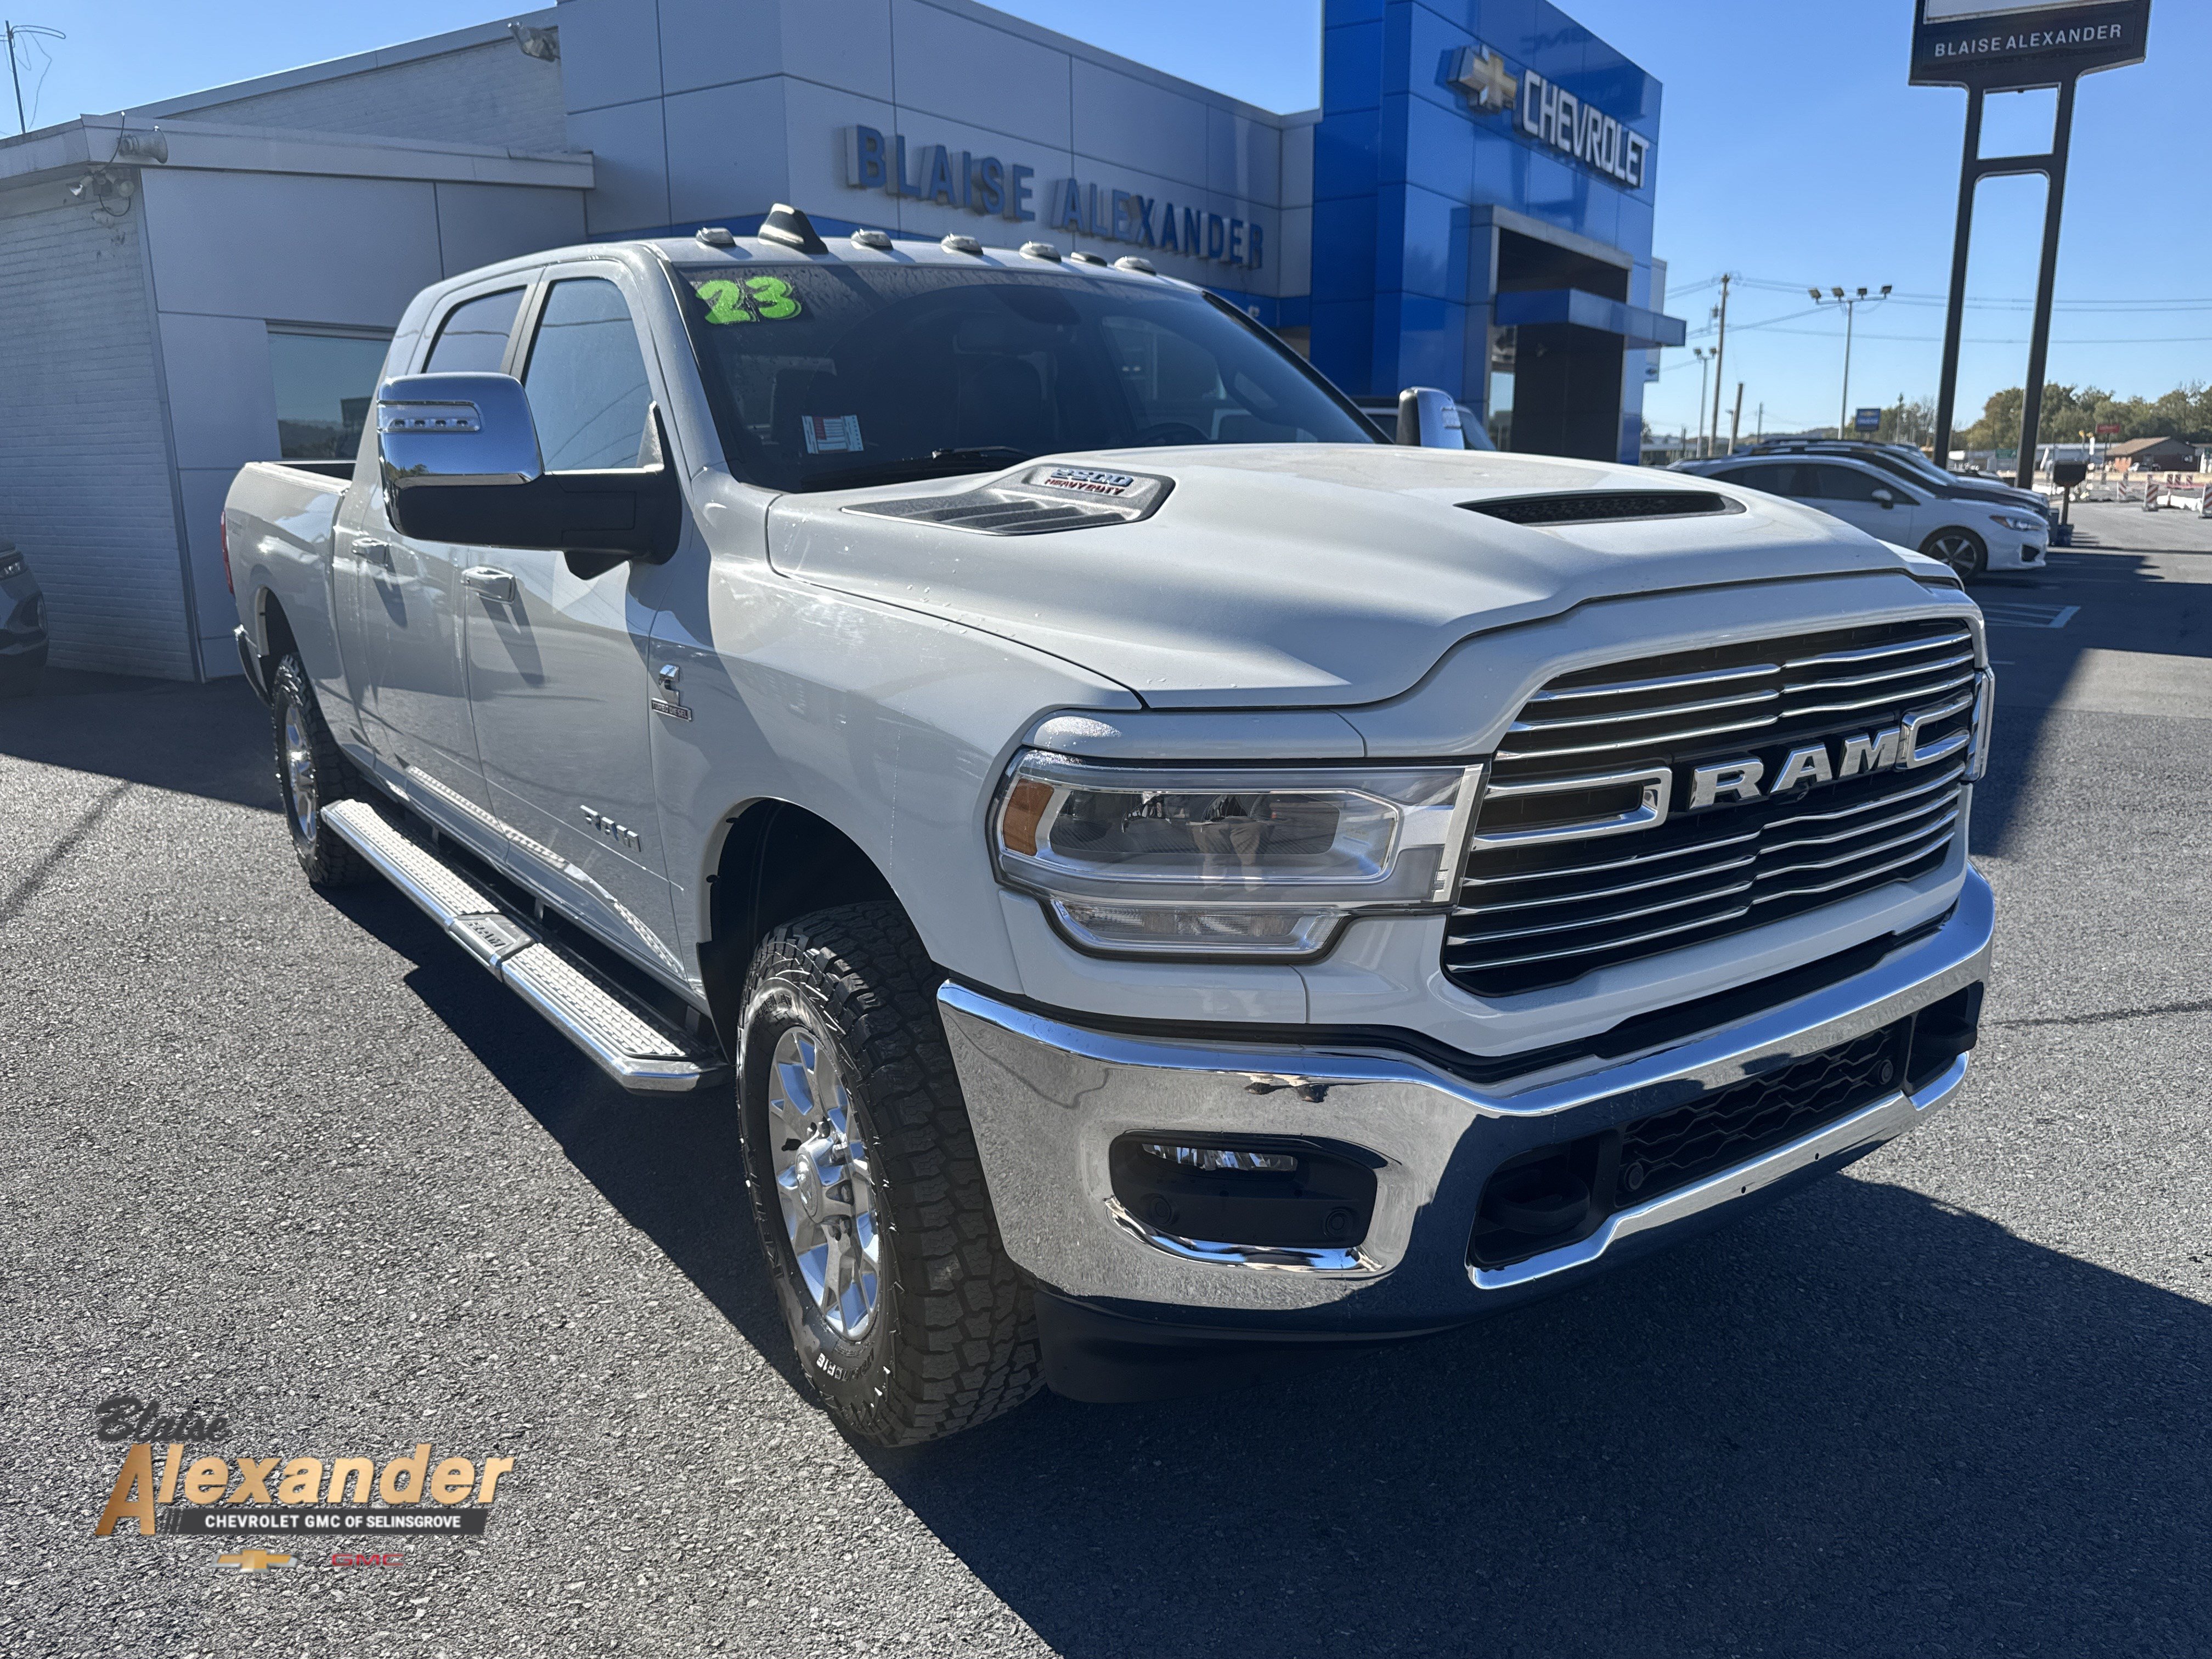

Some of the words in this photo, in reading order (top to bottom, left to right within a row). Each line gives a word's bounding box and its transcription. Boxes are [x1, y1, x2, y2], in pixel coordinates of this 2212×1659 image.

[1934, 37, 2001, 57] BLAISE
[2005, 24, 2122, 50] ALEXANDER
[1523, 69, 1649, 189] CHEVROLET
[848, 124, 1036, 222] BLAISE
[1052, 178, 1264, 269] ALEXANDER
[696, 276, 802, 325] 23
[1045, 479, 1087, 489] HEAVY
[1085, 484, 1125, 495] DUTY
[652, 702, 669, 713] TURBO
[669, 707, 689, 719] DIESEL
[1689, 726, 1902, 810] RAM
